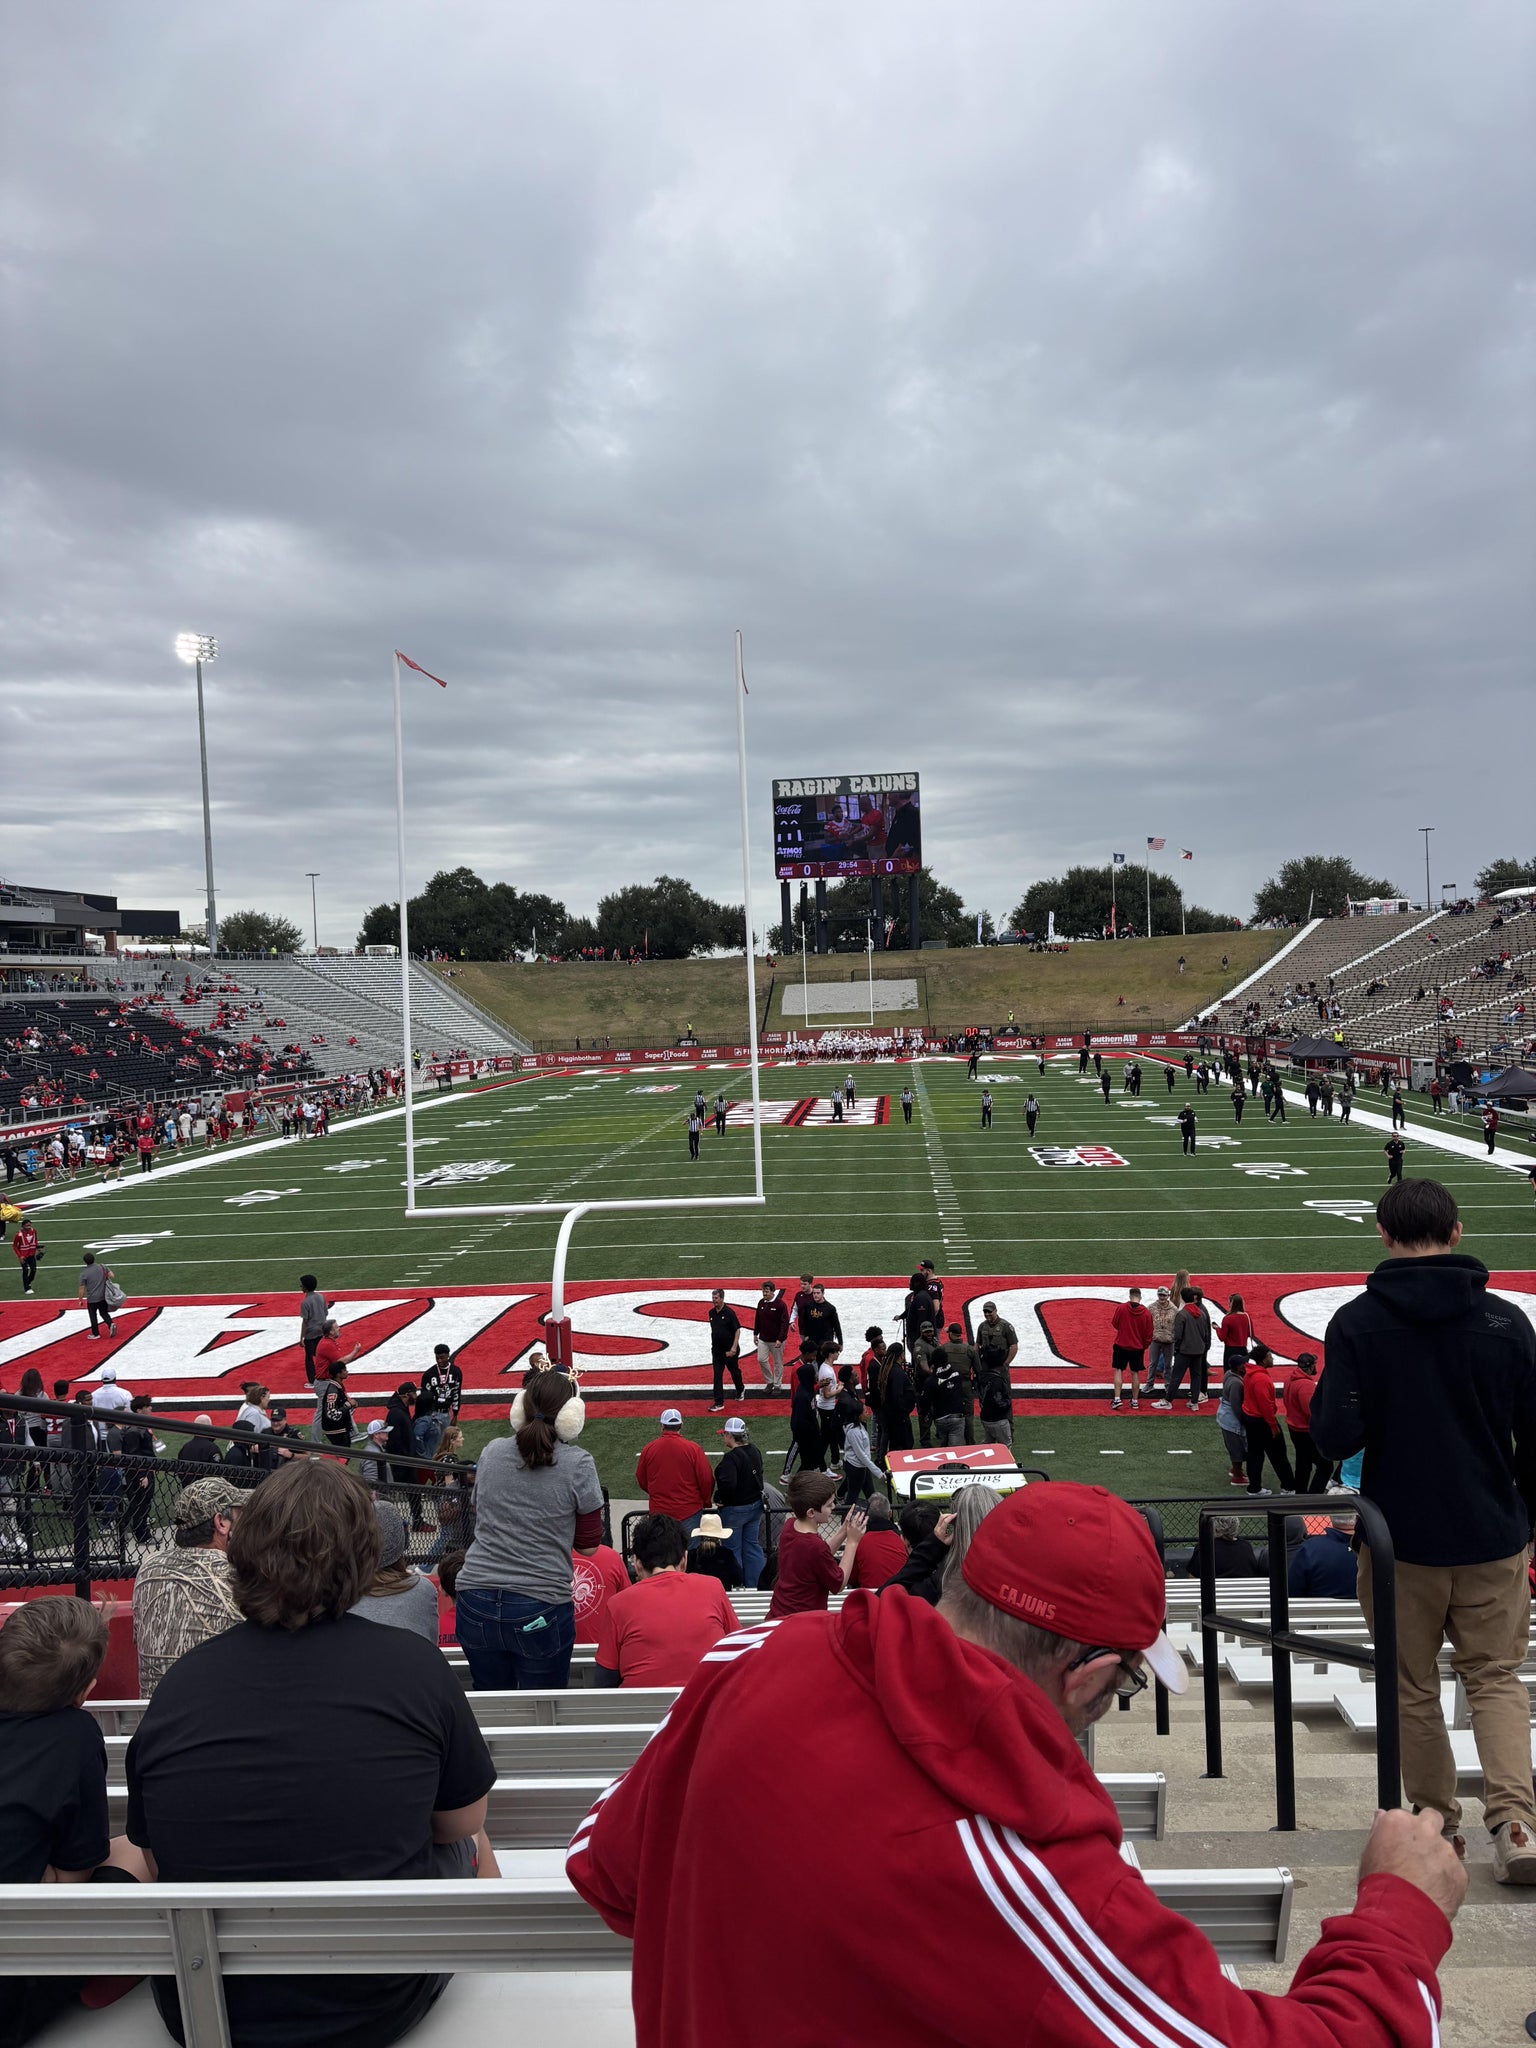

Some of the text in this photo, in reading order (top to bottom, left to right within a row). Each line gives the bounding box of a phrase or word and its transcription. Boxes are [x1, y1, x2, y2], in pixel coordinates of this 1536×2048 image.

[777, 774, 917, 798] RAGIN' CAJUNS
[803, 864, 811, 875] 0
[886, 861, 894, 872] 0
[841, 1029, 871, 1038] SIGNS
[997, 1039, 1017, 1047] Super
[558, 1054, 601, 1062] Higginbotham
[644, 1051, 663, 1059] Super
[670, 1050, 689, 1058] Foods
[938, 1474, 1002, 1485] Sterling
[999, 1584, 1057, 1620] CAJUNS
